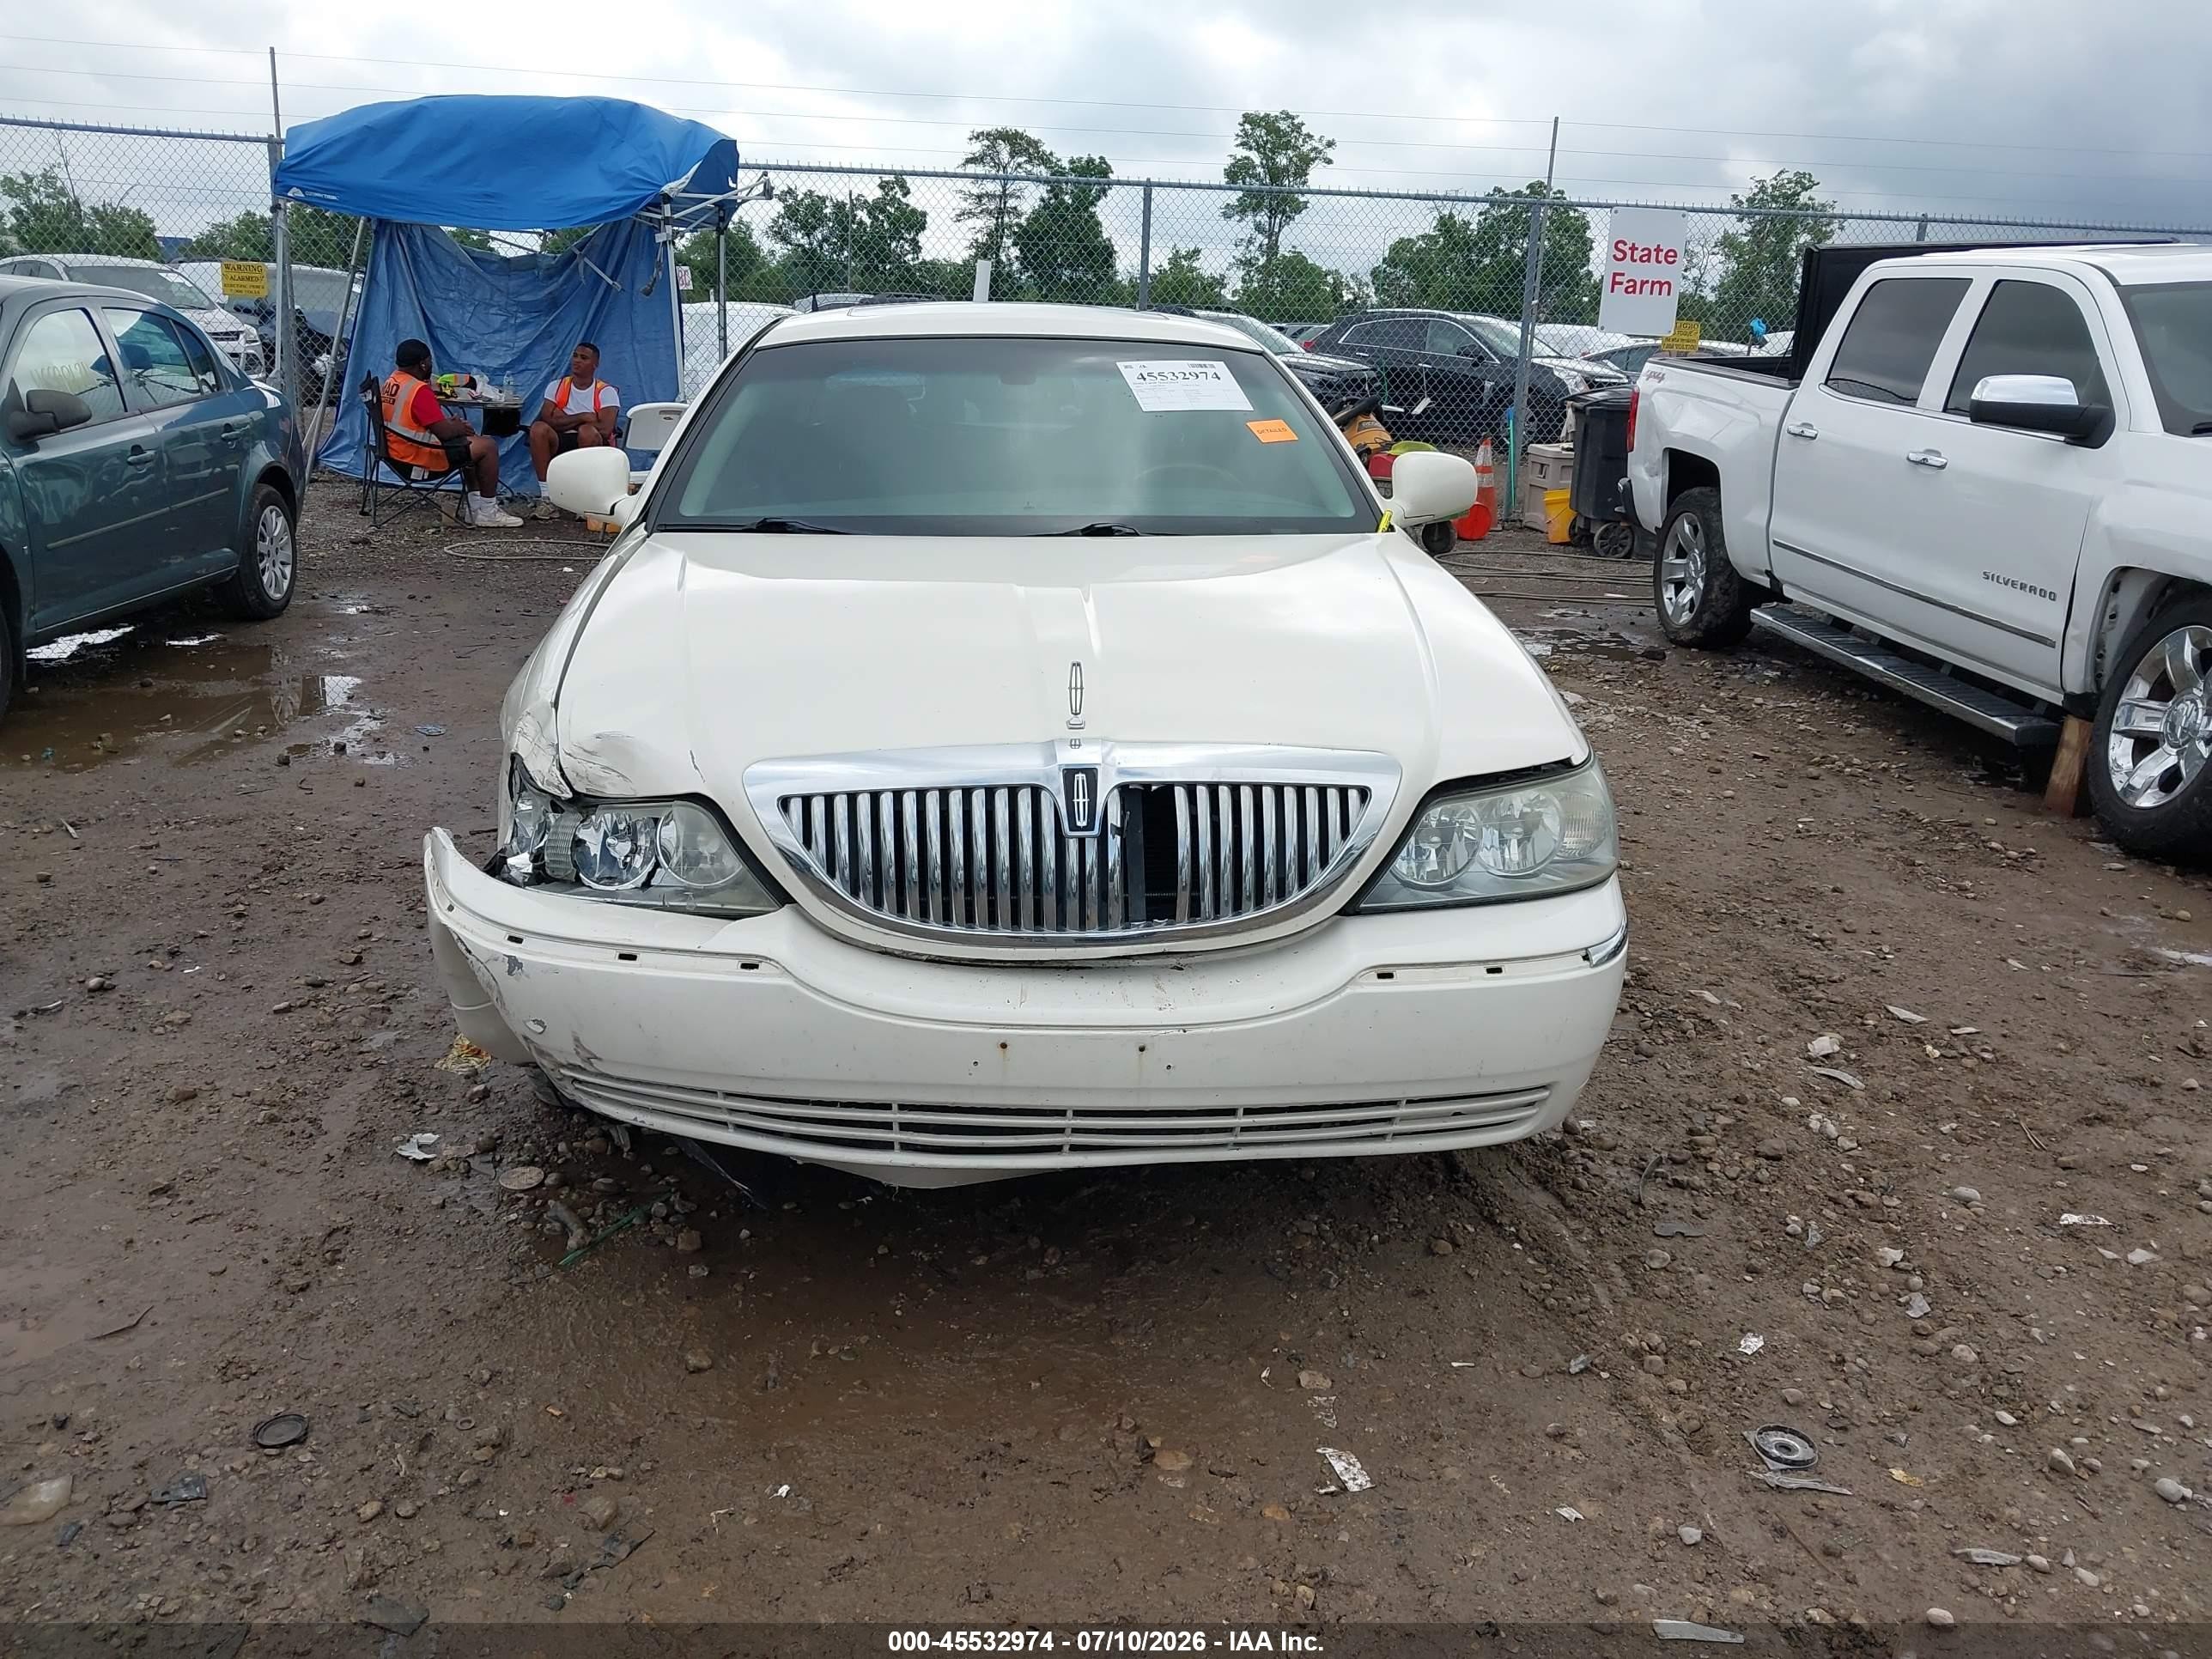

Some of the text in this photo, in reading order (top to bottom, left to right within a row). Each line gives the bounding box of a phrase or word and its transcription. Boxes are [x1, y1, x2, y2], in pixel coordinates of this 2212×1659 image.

[1613, 240, 1678, 265] State
[224, 264, 263, 273] WARNING
[1610, 272, 1673, 296] Farm
[1137, 371, 1221, 382] 45532974
[1982, 571, 2057, 602] SILVERADO
